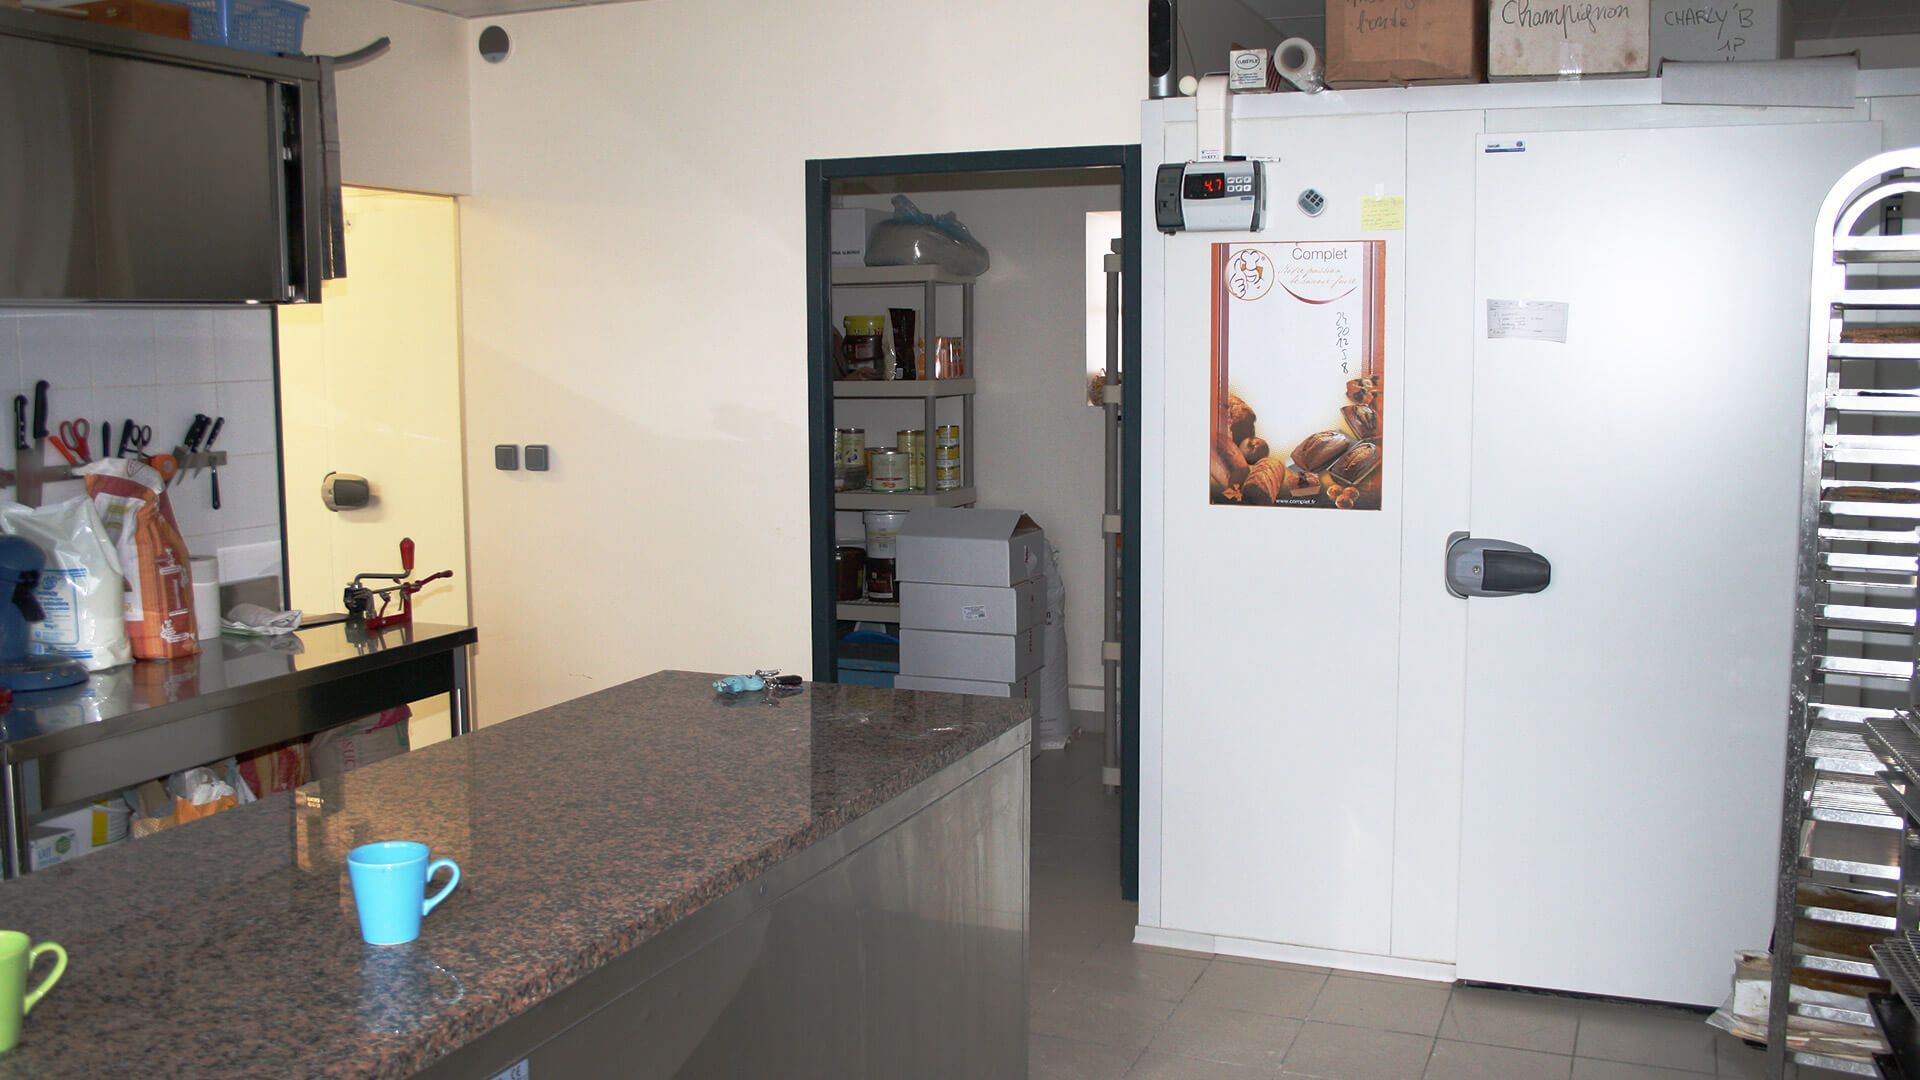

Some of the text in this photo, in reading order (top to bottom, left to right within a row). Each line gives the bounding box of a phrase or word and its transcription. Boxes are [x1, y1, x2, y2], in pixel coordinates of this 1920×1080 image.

[1501, 0, 1630, 38] Champignon
[1204, 178, 1223, 192] 4.7
[1292, 247, 1348, 262] Complet
[1336, 326, 1350, 338] 20
[1336, 337, 1349, 349] 12
[1341, 361, 1349, 375] 8
